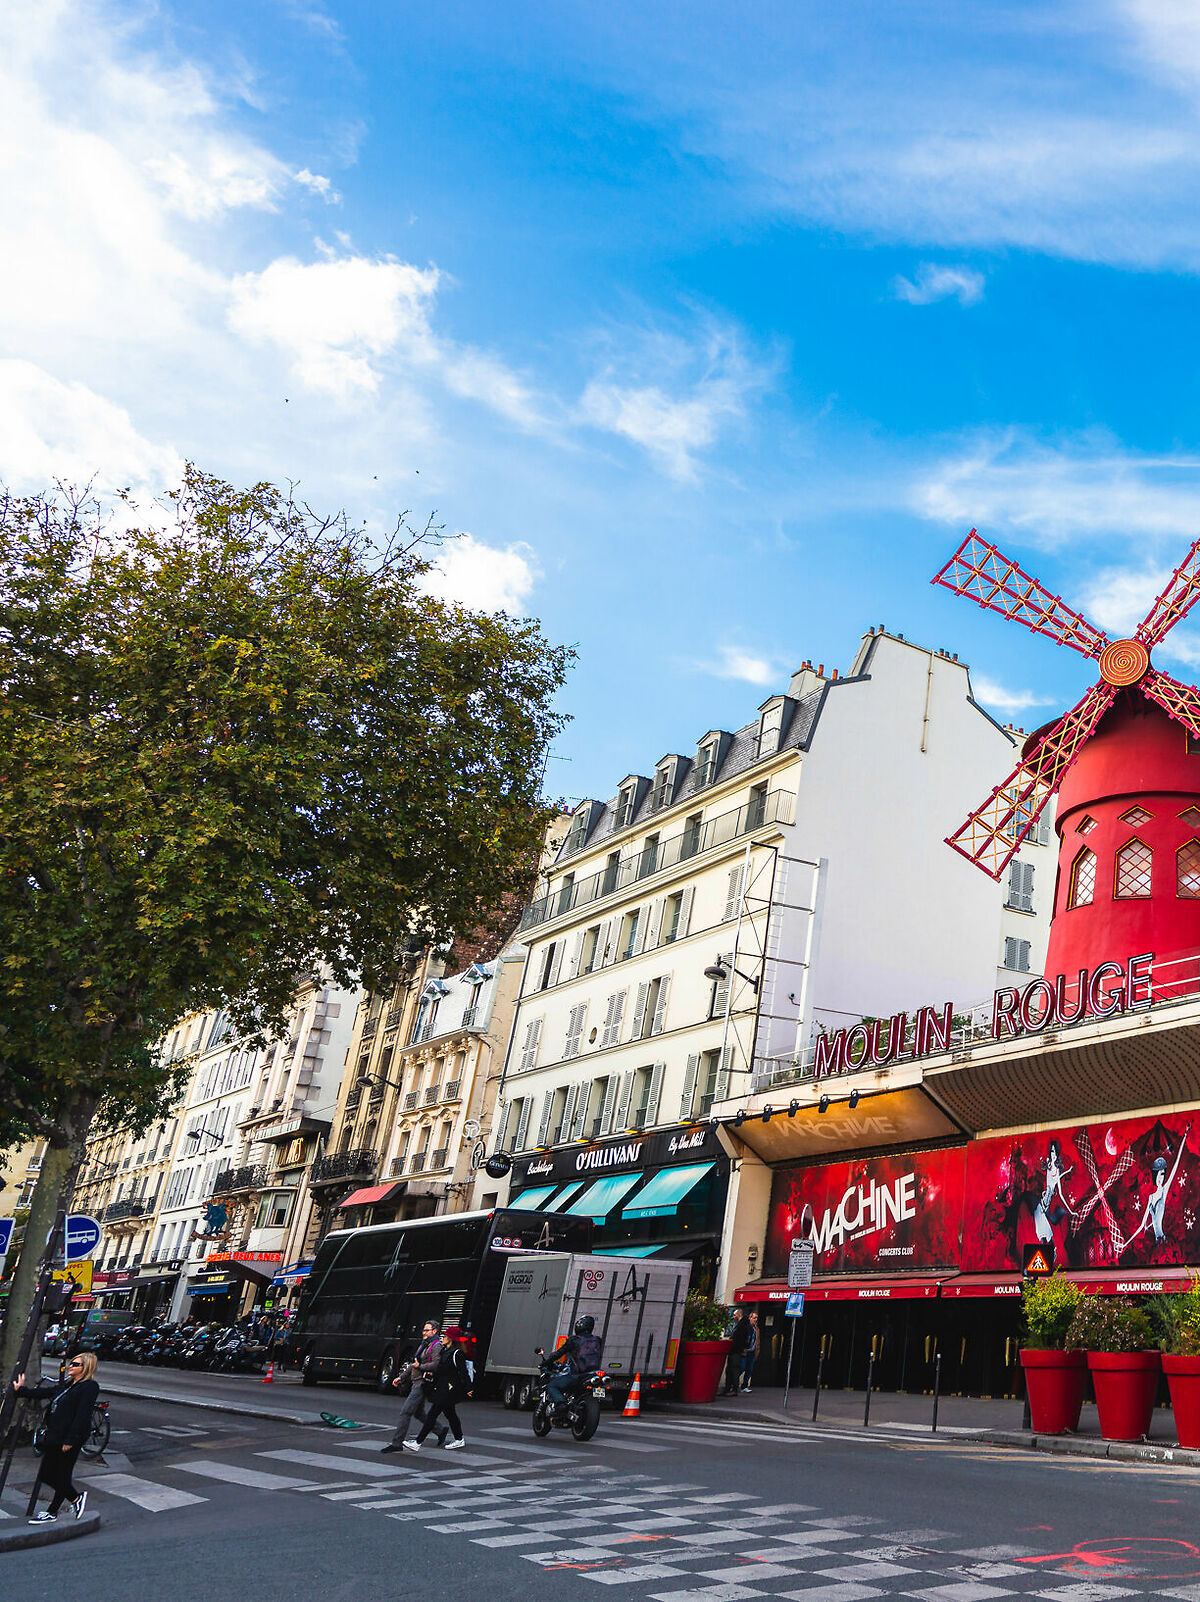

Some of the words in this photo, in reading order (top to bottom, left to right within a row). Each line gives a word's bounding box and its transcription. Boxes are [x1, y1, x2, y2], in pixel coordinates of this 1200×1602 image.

[813, 1001, 953, 1079] MOULIN
[992, 951, 1156, 1039] ROUGE
[575, 1142, 643, 1171] O'SULLIVANS
[809, 1172, 916, 1254] MACHINE
[879, 1247, 901, 1256] CONCERTS
[901, 1246, 914, 1255] CLUB
[994, 1286, 1013, 1294] MOULIN
[1116, 1282, 1140, 1292] MOULIN
[1140, 1282, 1163, 1291] ROUGE
[858, 1289, 875, 1297] MOULIN
